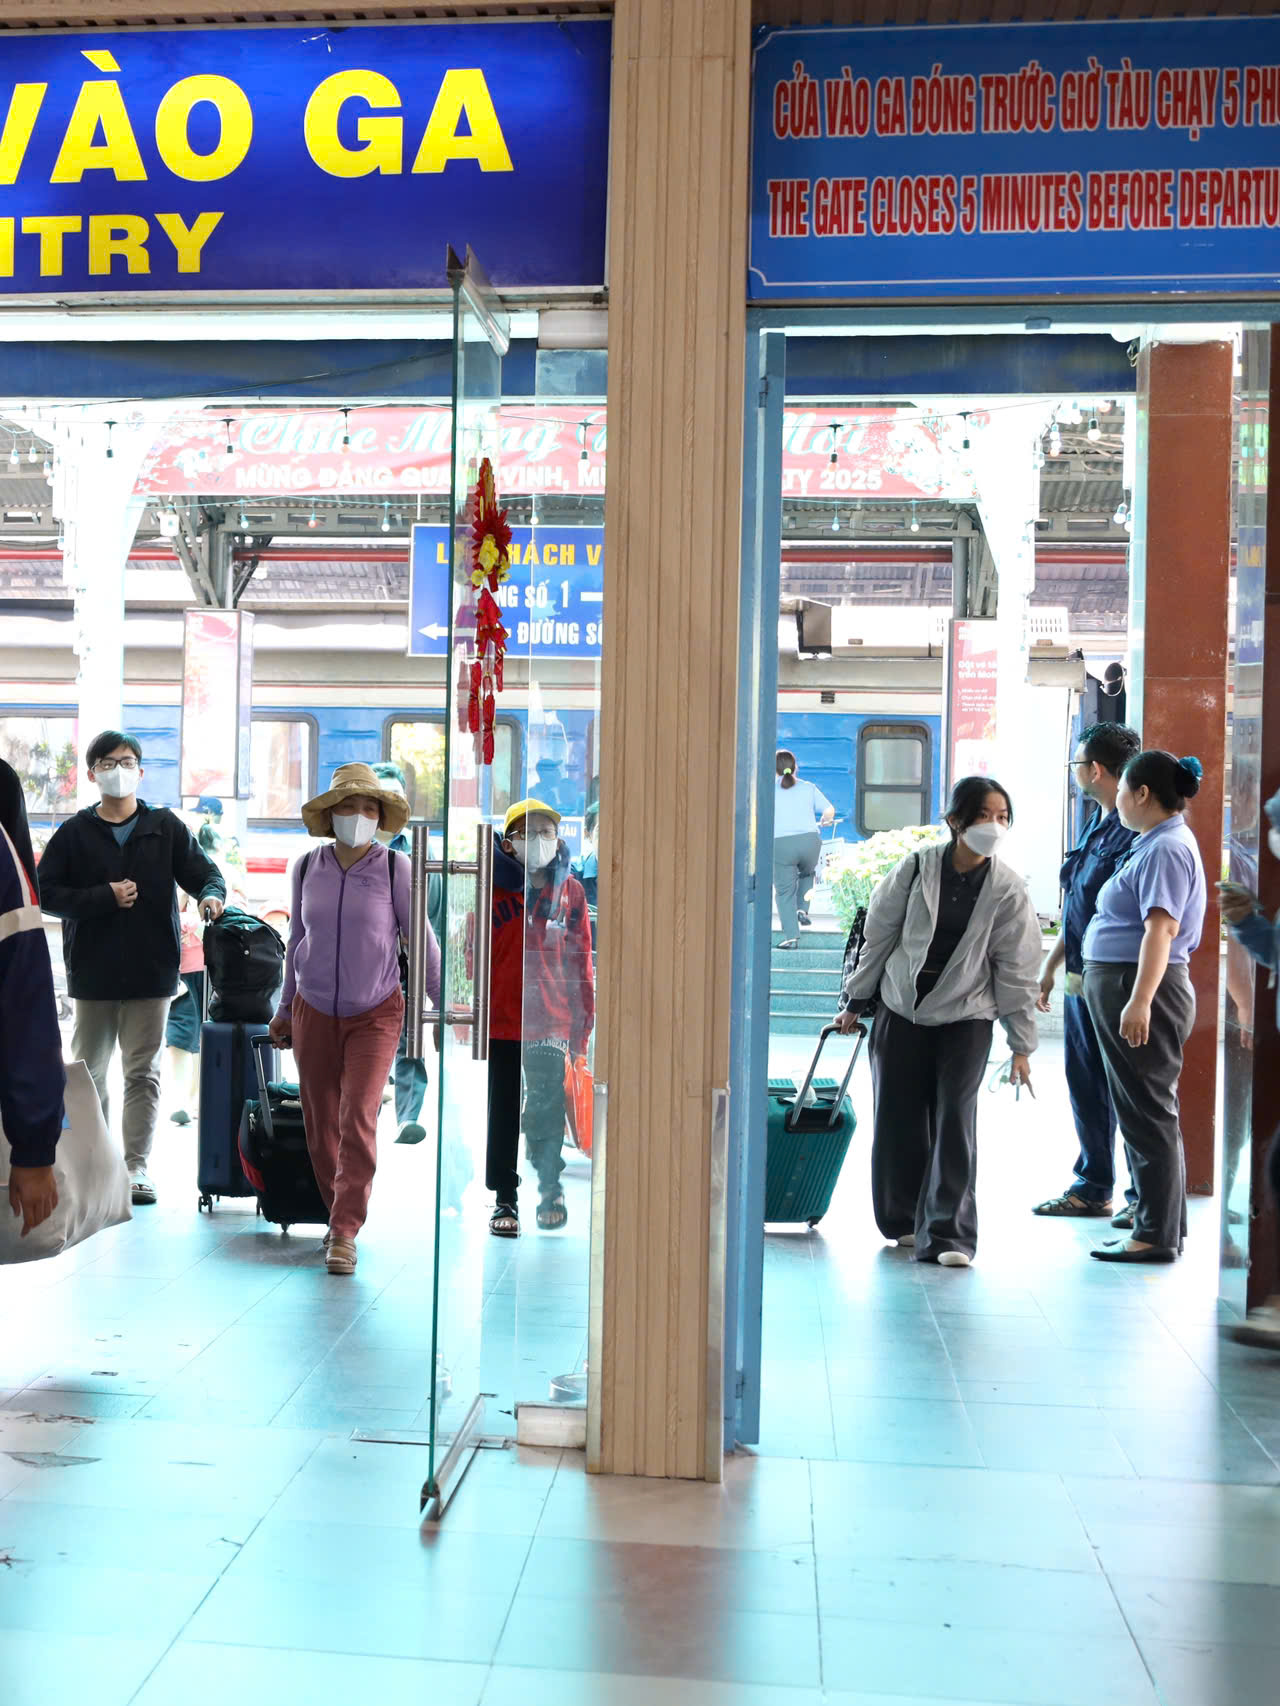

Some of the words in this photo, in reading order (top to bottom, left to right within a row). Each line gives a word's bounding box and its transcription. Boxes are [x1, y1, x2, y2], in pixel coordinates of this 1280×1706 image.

[304, 68, 515, 178] GA
[773, 60, 820, 139] CỬA
[825, 66, 871, 138] VÀO
[875, 77, 907, 136] GA
[911, 64, 976, 134] ĐÓNG
[980, 61, 1056, 133] TRƯỚC
[1060, 57, 1104, 132] GIỜ
[1106, 57, 1151, 131] TÀU
[1155, 68, 1220, 141] CHẠY
[1222, 66, 1240, 128] 5
[1243, 65, 1280, 127] PH
[768, 178, 811, 238] THE
[813, 177, 867, 237] GATE
[870, 174, 958, 236] CLOSES
[960, 174, 977, 233] 5
[980, 172, 1083, 233] MINUTES
[1085, 170, 1174, 231] BEFORE
[385, 410, 563, 463] Mng
[235, 460, 313, 489] MỪNG
[820, 468, 883, 490] 2025
[524, 579, 550, 609] SỐ
[560, 579, 569, 609] 1
[517, 617, 580, 645] ĐƯỜNG
